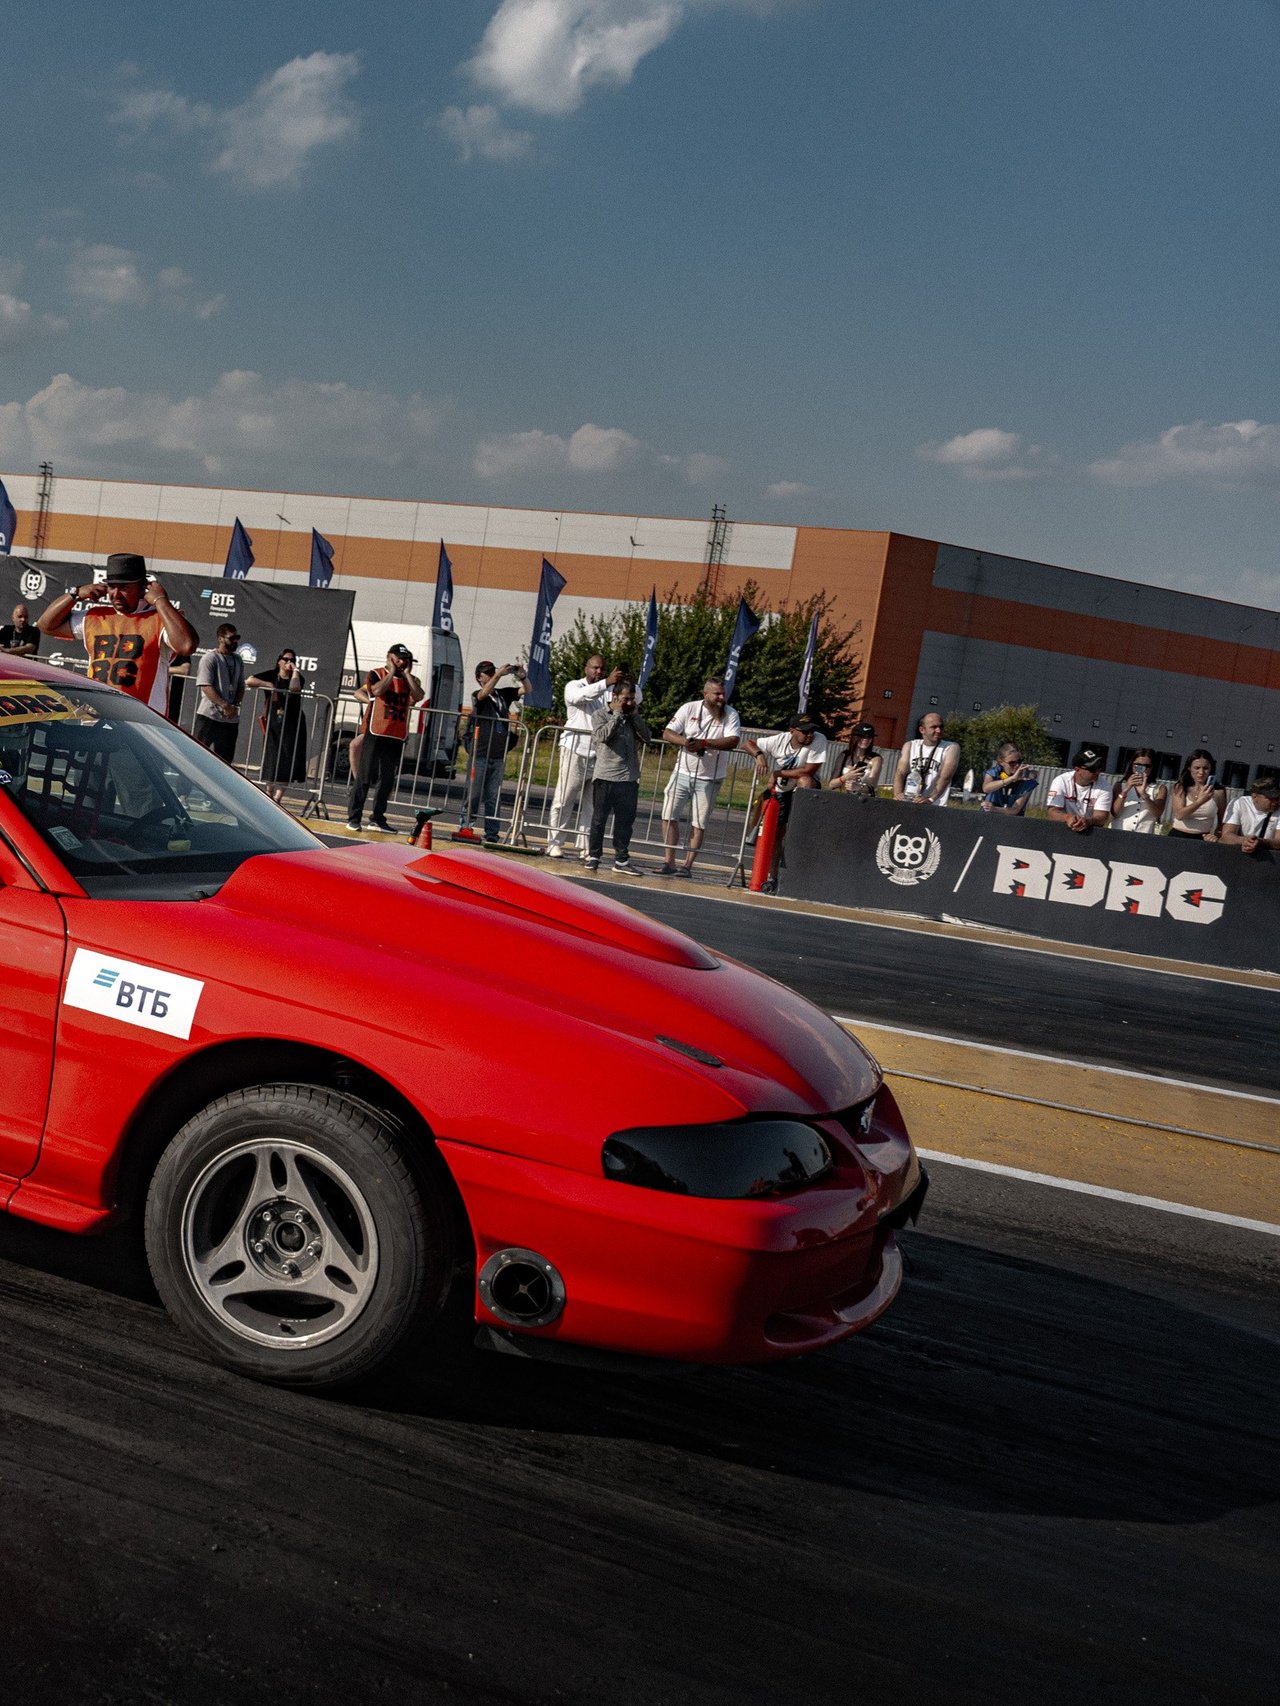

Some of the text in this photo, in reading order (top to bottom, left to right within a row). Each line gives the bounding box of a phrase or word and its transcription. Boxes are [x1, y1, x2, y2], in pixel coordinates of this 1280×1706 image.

[211, 593, 235, 606] ВТБ
[993, 845, 1227, 925] RDRC
[116, 980, 171, 1018] ВТБ
